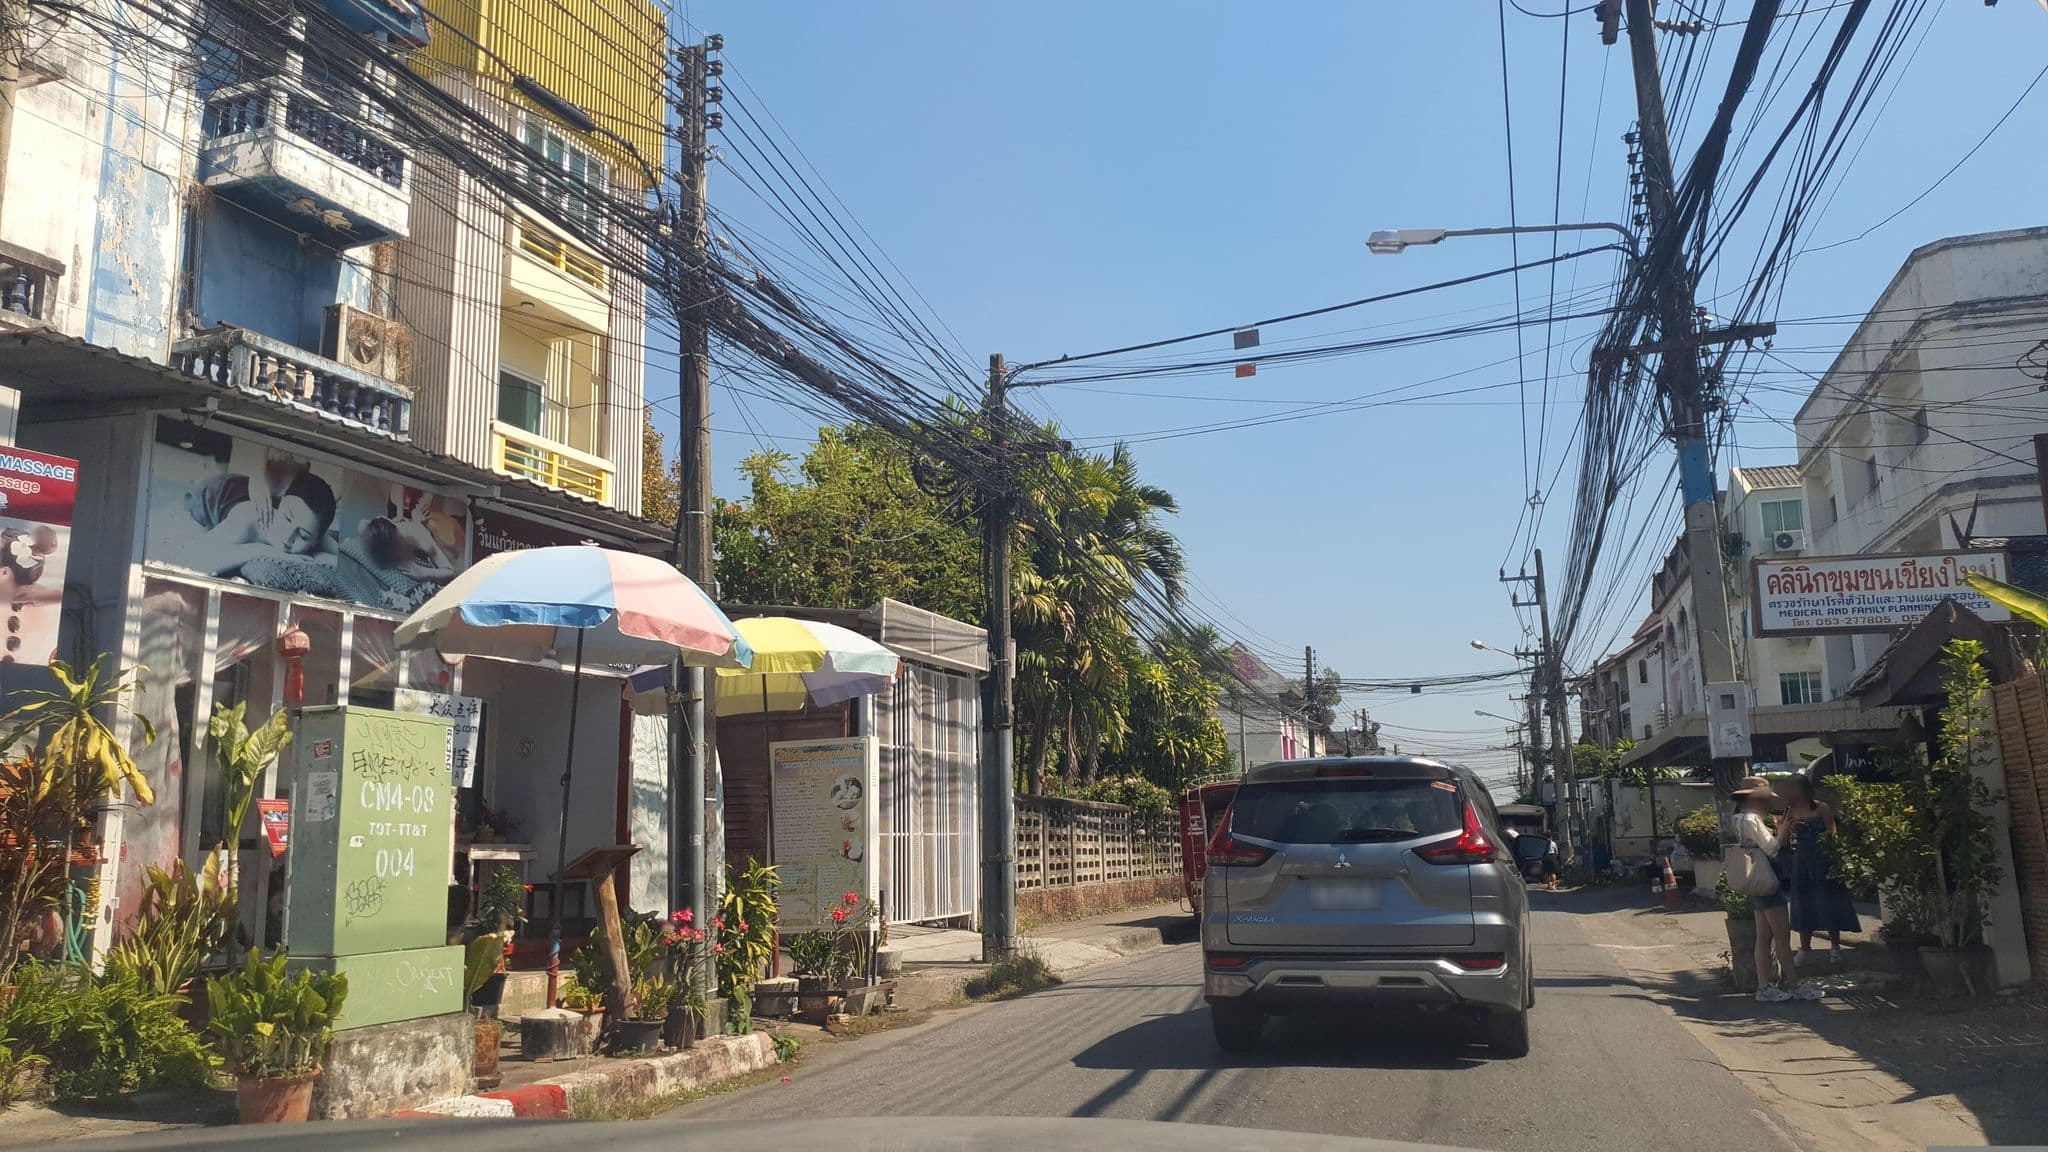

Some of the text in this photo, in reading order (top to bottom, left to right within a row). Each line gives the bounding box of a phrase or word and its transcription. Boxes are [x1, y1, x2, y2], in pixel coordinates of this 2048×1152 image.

[0, 454, 75, 482] MASSAGE
[0, 475, 40, 494] ssage
[1779, 607, 1824, 617] MEDICAL
[1827, 605, 1848, 616] AND
[1852, 605, 1886, 615] FAMILY
[1816, 615, 1892, 627] 053-277805
[360, 780, 435, 813] CM4-08
[368, 822, 428, 837] TOT-TT&T
[375, 848, 415, 878] 004
